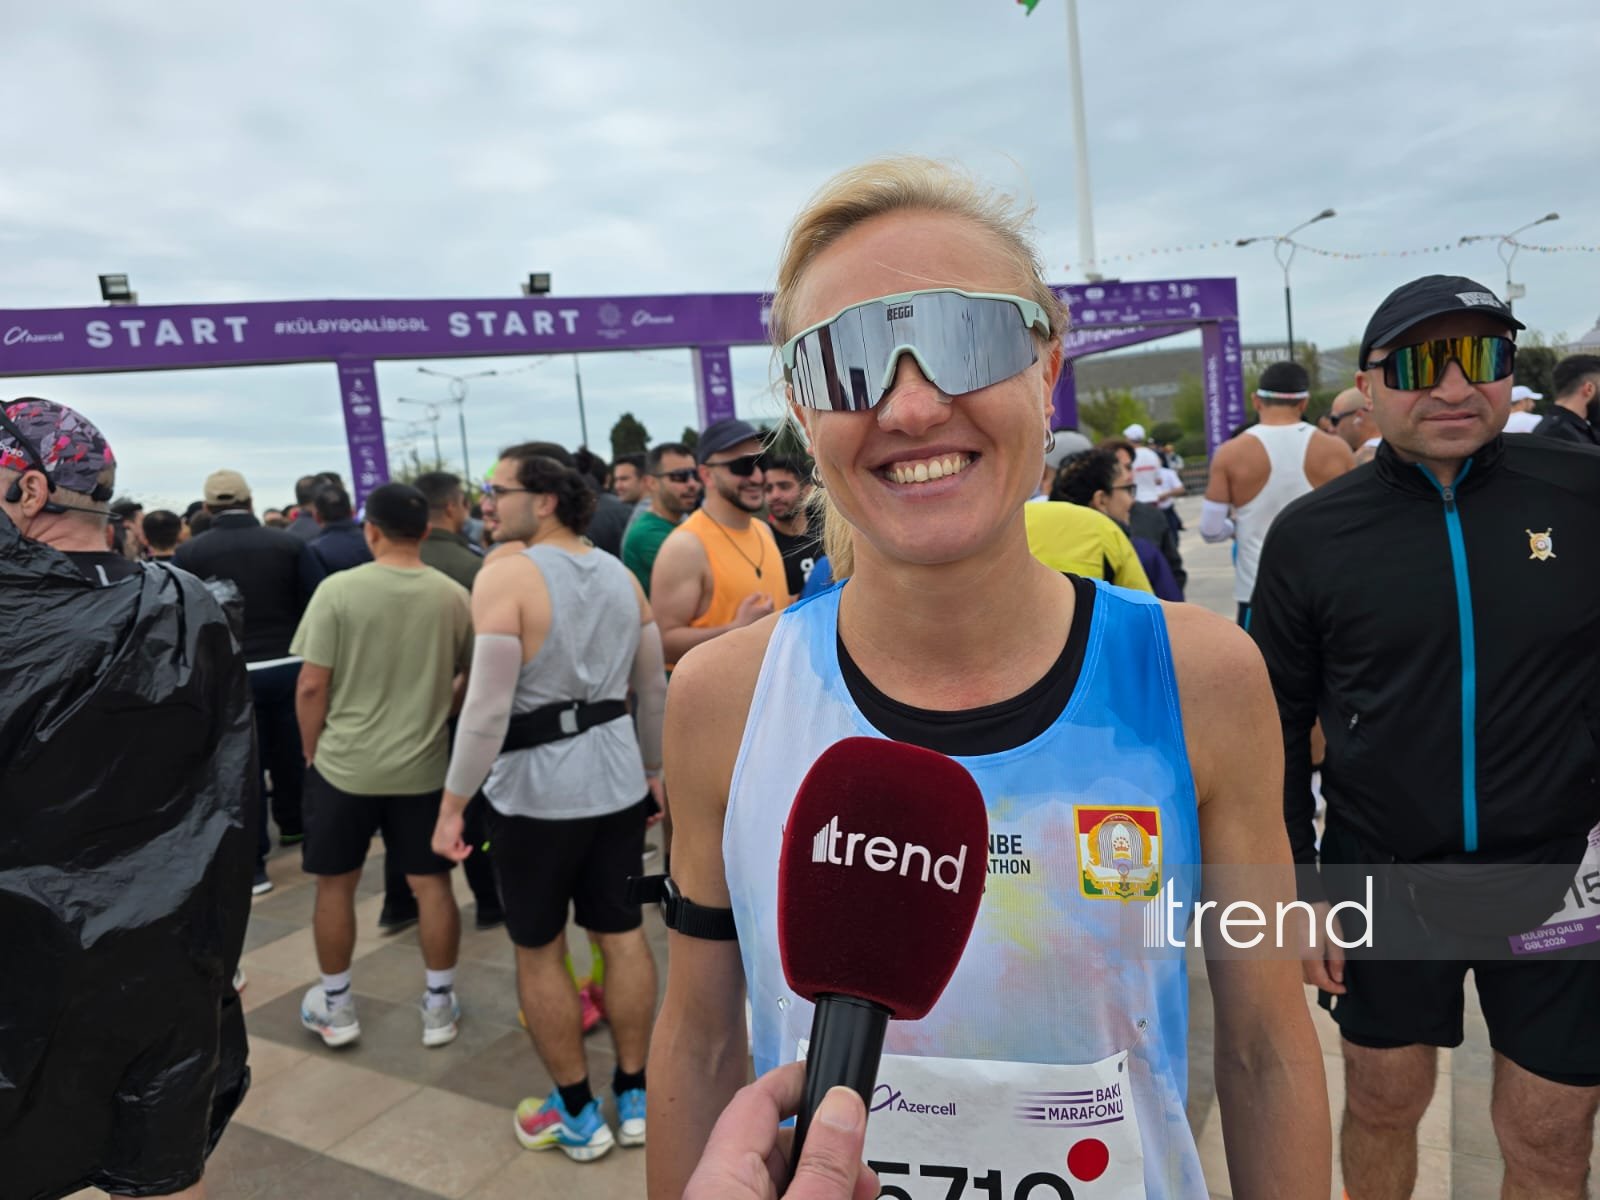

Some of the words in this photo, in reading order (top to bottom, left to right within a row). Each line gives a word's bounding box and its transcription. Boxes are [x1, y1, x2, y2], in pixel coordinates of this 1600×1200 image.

[887, 305, 914, 321] BEGGI
[86, 317, 249, 348] START
[448, 310, 580, 338] START
[827, 815, 968, 894] trend
[1543, 936, 1567, 948] 2026
[1096, 1082, 1121, 1102] BAKI
[897, 1098, 957, 1116] Azercell
[1048, 1098, 1123, 1121] MARAFONU
